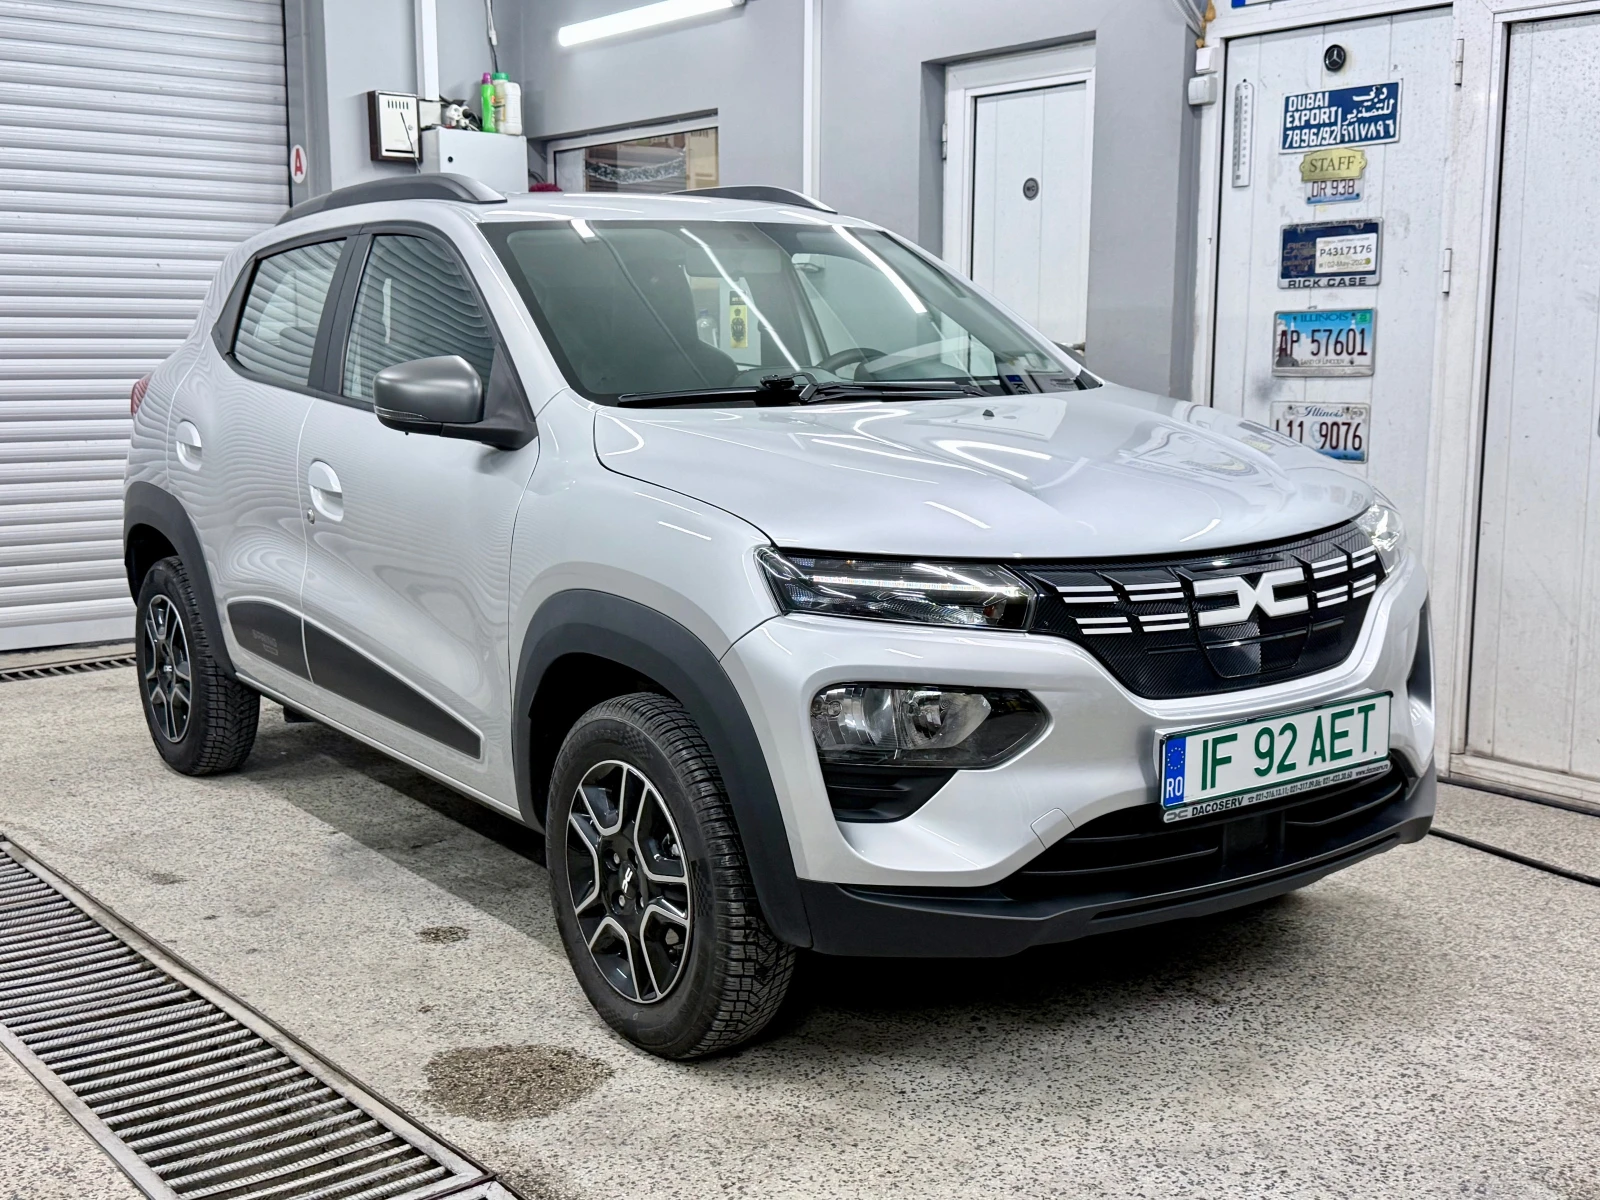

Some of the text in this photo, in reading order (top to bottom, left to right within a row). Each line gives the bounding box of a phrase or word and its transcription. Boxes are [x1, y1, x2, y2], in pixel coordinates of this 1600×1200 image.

[1288, 92, 1329, 111] DUBAI
[1285, 106, 1338, 128] EXPORT
[1285, 126, 1338, 148] 7896/92
[294, 147, 304, 177] A
[1309, 155, 1356, 172] STAFF
[1319, 244, 1373, 258] P4317176
[1288, 276, 1367, 288] RICK CASE
[1300, 312, 1349, 322] ILLINOIS
[1279, 327, 1368, 357] AP 57601
[1302, 405, 1344, 417] Illinois
[1319, 421, 1363, 451] 9076
[1201, 703, 1376, 791] IF 92 AET
[1166, 776, 1183, 799] RO
[1191, 796, 1244, 816] DACOSERV
